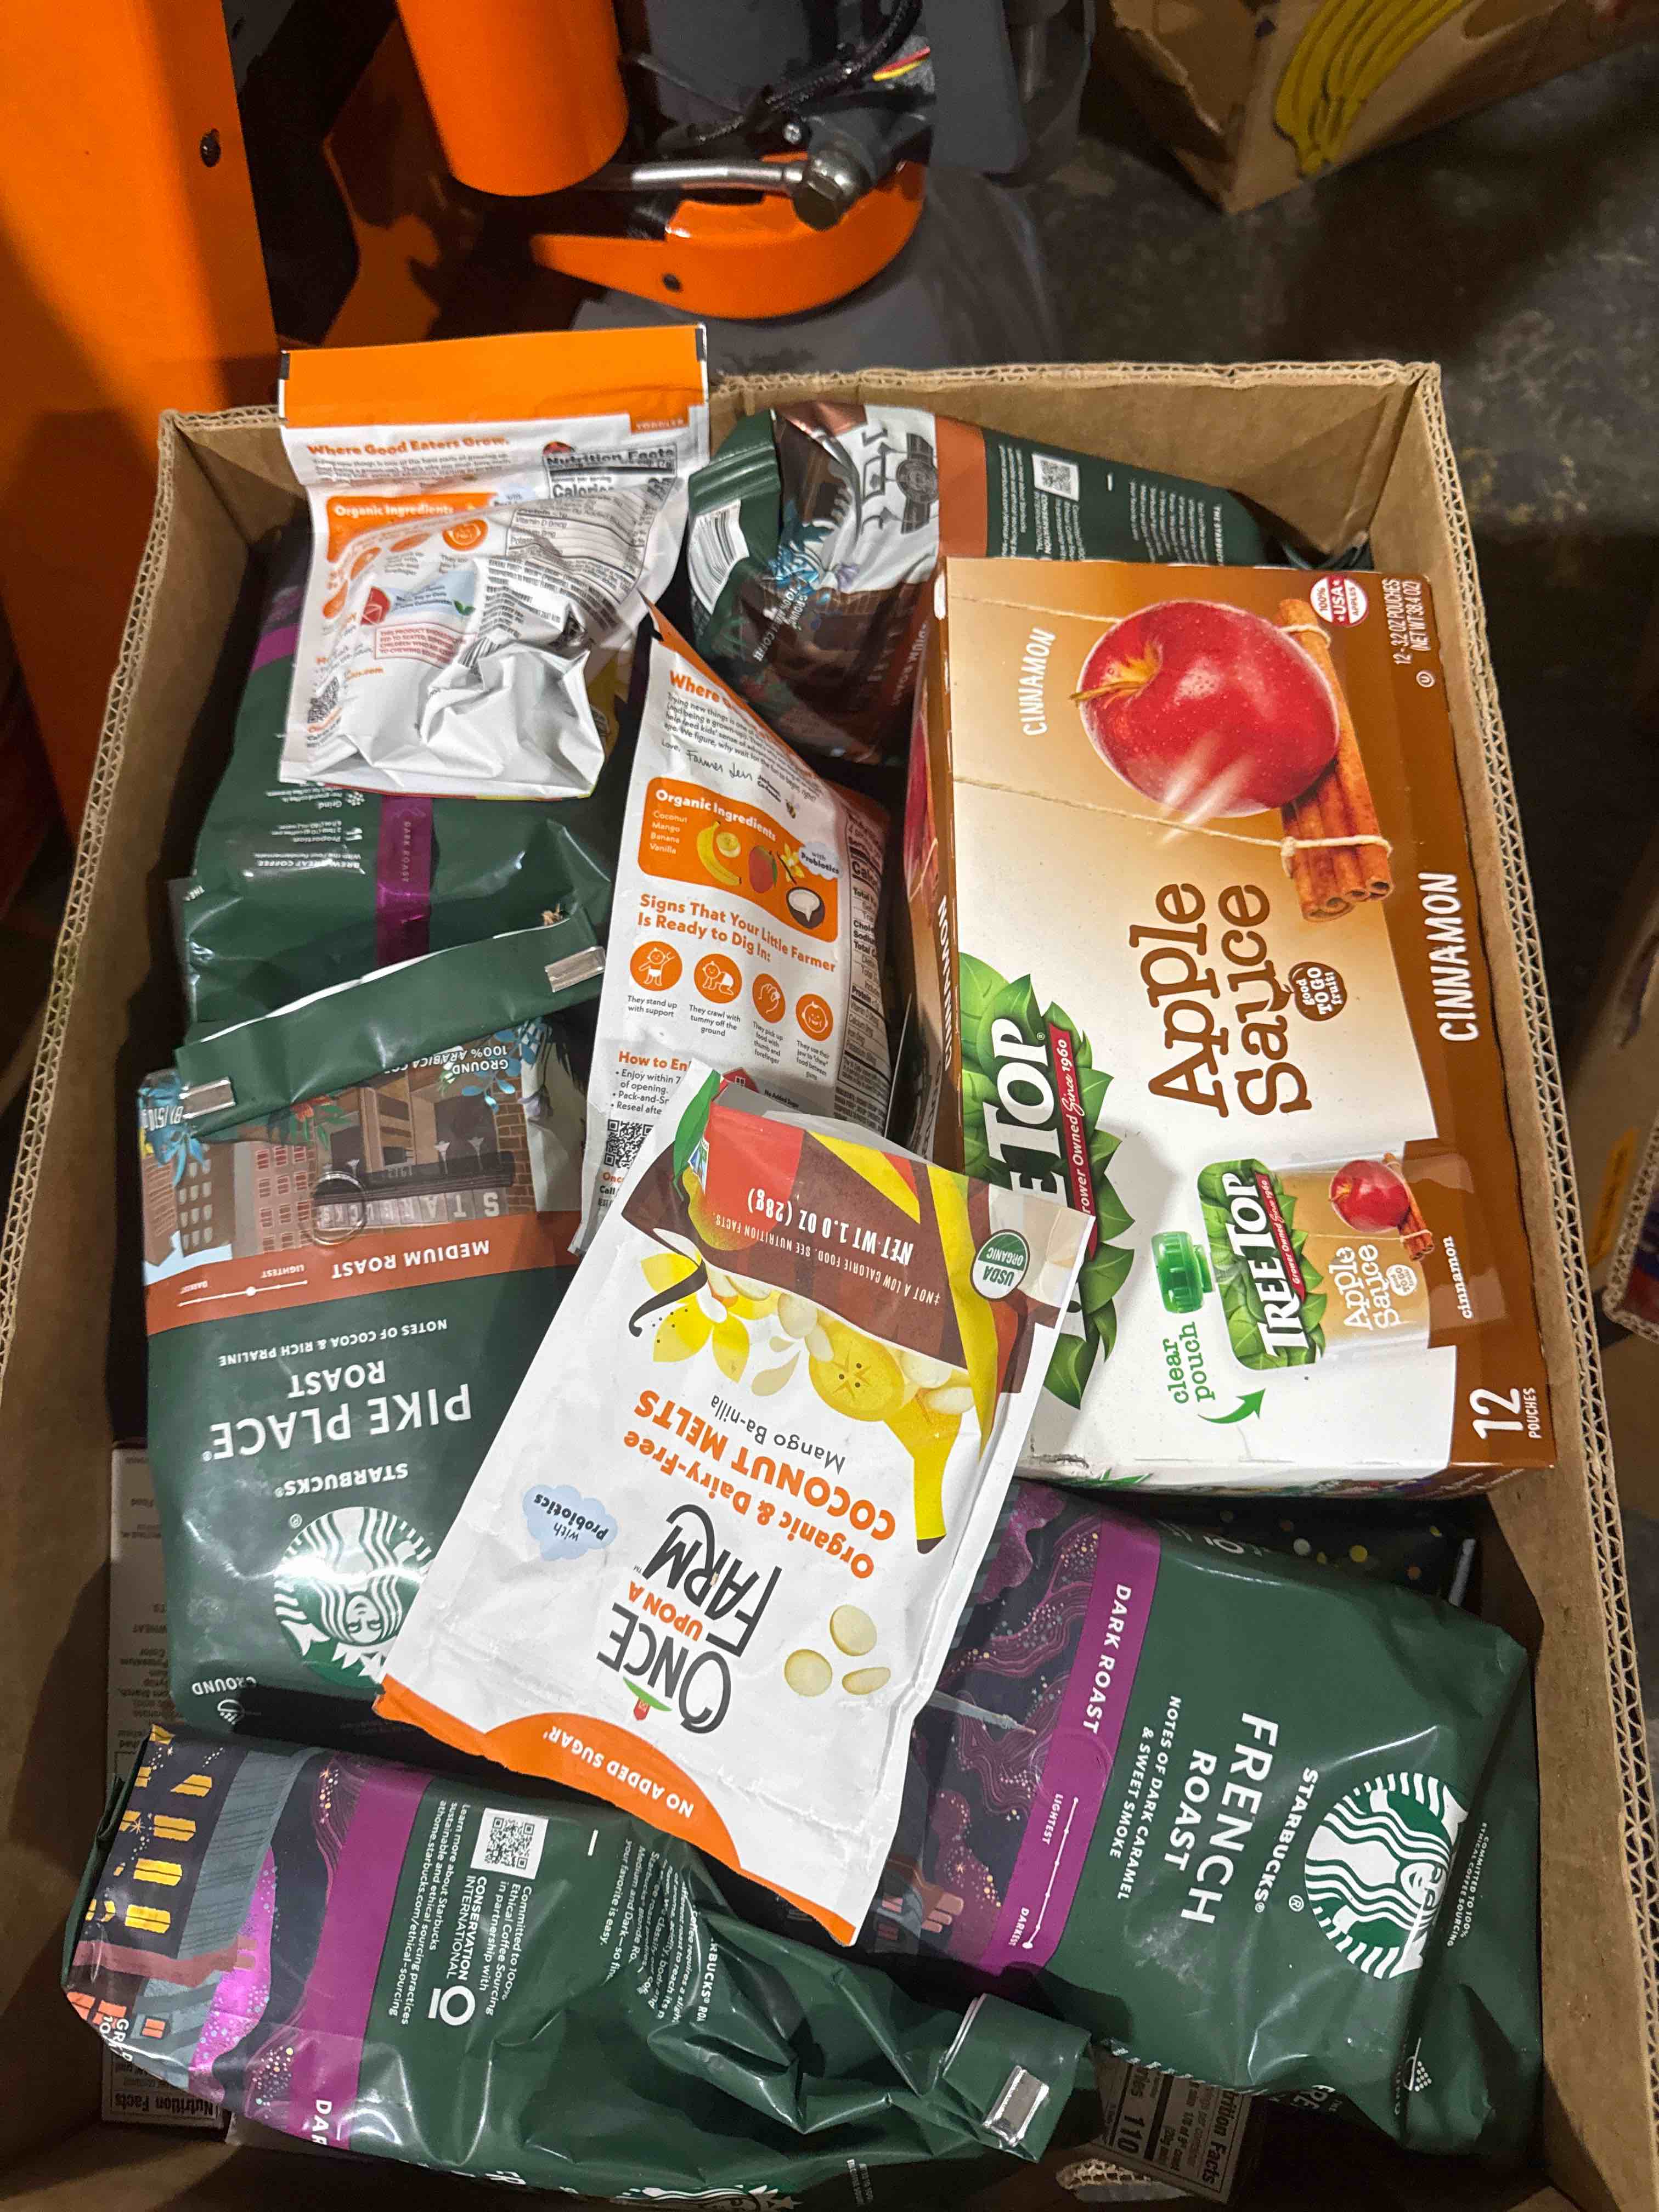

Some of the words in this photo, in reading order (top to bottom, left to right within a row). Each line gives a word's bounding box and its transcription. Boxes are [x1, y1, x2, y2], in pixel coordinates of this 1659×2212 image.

[307, 444, 361, 455] Where
[364, 441, 407, 455] Good
[410, 439, 460, 451] Eaters
[547, 453, 622, 466] Nutrition
[628, 448, 674, 460] Facts
[1331, 586, 1346, 614] USA
[1348, 588, 1359, 616] APPLES
[1382, 579, 1404, 619] POUCHES
[1403, 580, 1420, 595] OZ)
[1405, 597, 1424, 615] 38.4
[1408, 615, 1426, 630] WT
[1409, 632, 1430, 651] (NET
[669, 670, 720, 703] Where
[1022, 628, 1056, 737] CINNAMON
[668, 692, 689, 708] Trying
[690, 703, 706, 713] new
[707, 708, 728, 723] things
[686, 748, 723, 773] Farmer
[652, 822, 681, 833] Mango
[653, 811, 687, 823] Coconut
[656, 789, 712, 811] Organic
[713, 802, 776, 842] Ingredients
[650, 832, 680, 844] Banana
[650, 843, 676, 854] Vanilla
[637, 912, 651, 926] Is
[656, 915, 708, 940] Ready
[712, 926, 727, 941] to
[731, 932, 754, 955] Dig
[640, 893, 685, 913] Signs
[690, 901, 726, 923] That
[730, 912, 760, 934] Your
[761, 927, 789, 955] Little
[791, 945, 836, 973] Farmer
[1417, 872, 1480, 1042] CINNAMON
[938, 896, 952, 1071] CINNAMON
[1296, 979, 1315, 1005] good
[1307, 967, 1325, 990] GO
[628, 995, 644, 1007] They
[646, 998, 666, 1007] stand
[628, 1005, 644, 1013] with
[646, 1008, 674, 1018] support
[689, 1004, 706, 1016] They
[707, 1009, 725, 1019] crawl
[1128, 882, 1230, 1119] Apple
[1216, 883, 1311, 1115] Sauce
[1314, 992, 1333, 1014] TO
[691, 1015, 714, 1027] tummy
[701, 1026, 725, 1037] ground
[753, 1021, 766, 1034] They
[412, 1051, 467, 1068] ARABICA
[619, 1051, 651, 1066] How
[653, 1057, 668, 1068] to
[797, 1040, 810, 1052] They
[1057, 1039, 1074, 1072] 1960
[621, 1069, 645, 1082] Enjoy
[647, 1074, 674, 1084] within
[983, 1018, 1062, 1163] TOP
[617, 1102, 644, 1113] Reseal
[1065, 1116, 1087, 1166] Owned
[747, 1188, 793, 1224] (28g)
[799, 1209, 817, 1233] OZ
[1222, 1172, 1274, 1256] TOP
[712, 1213, 741, 1236] FACTS.
[744, 1224, 793, 1251] NUTRITION
[823, 1217, 849, 1243] 1.0
[853, 1227, 877, 1253] WT
[331, 1254, 396, 1279] ROAST
[404, 1240, 490, 1266] MEDIUM
[795, 1242, 811, 1258] SEE
[815, 1248, 841, 1268] FOOD.
[881, 1238, 913, 1266] NET
[985, 1247, 1024, 1267] ORGANIC
[844, 1258, 881, 1284] CALORIE
[885, 1275, 902, 1293] LOW
[983, 1266, 1015, 1286] USDA
[1358, 1244, 1401, 1328] Sauce
[1442, 1237, 1473, 1319] cinnamon
[1329, 1247, 1373, 1329] Apple
[1248, 1256, 1310, 1356] TREE
[331, 1330, 376, 1346] COCOA
[380, 1327, 398, 1338] OF
[401, 1318, 447, 1335] NOTES
[219, 1347, 276, 1366] PRALINE
[280, 1341, 313, 1356] RICH
[317, 1339, 327, 1350] &
[1178, 1321, 1214, 1401] pouch
[287, 1360, 385, 1398] ROAST
[1163, 1338, 1189, 1403] clear
[367, 1384, 471, 1435] PIKE
[634, 1389, 729, 1462] MELTS
[710, 1395, 767, 1446] Ba-nilla
[1470, 1389, 1522, 1440] 12
[1528, 1388, 1542, 1440] POUCHES
[773, 1432, 847, 1475] Mango
[623, 1430, 752, 1515] Dairy-Free
[731, 1447, 896, 1541] COCONUT
[534, 1493, 610, 1541] Probiotics
[756, 1500, 776, 1526] &
[553, 1522, 579, 1543] with
[778, 1511, 874, 1579] Organic
[628, 1581, 645, 1602] A
[642, 1504, 783, 1657] FARM
[642, 1592, 703, 1641] UPON
[1103, 1584, 1132, 1650] DARK
[596, 1602, 731, 1734] ONCE
[1082, 1654, 1115, 1734] ROAST
[1141, 1727, 1154, 1739] &
[1160, 1696, 1181, 1748] NOTES
[1127, 1743, 1150, 1796] SWEET
[1154, 1752, 1169, 1774] OF
[606, 1760, 664, 1800] ADDED
[666, 1793, 693, 1818] NO
[1141, 1778, 1165, 1822] DARK
[1164, 1750, 1217, 1871] ROAST
[437, 1803, 457, 1861] sustainable
[455, 1804, 470, 1832] Learn
[1041, 1793, 1064, 1844] LIGHTEST
[1109, 1801, 1136, 1859] SMOKE
[1180, 1712, 1279, 1924] FRENCH
[449, 1835, 462, 1862] more
[1118, 1826, 1150, 1901] CARAMEL
[1469, 1836, 1489, 1893] COMMITTED
[432, 1863, 443, 1883] and
[441, 1864, 455, 1896] about
[499, 1881, 509, 1892] in
[612, 1865, 629, 1905] favorite
[389, 1801, 447, 2016] athome.starbucks.com/ethical-sourcing
[424, 1885, 438, 1922] ethical
[504, 1883, 520, 1922] Ethical
[512, 1886, 532, 1951] Committed
[429, 1897, 447, 1950] Starbucks
[447, 1875, 476, 1979] INTERNATIONAL
[458, 1876, 487, 1980] CONSERVATION
[483, 1894, 503, 1962] partnership
[1008, 1907, 1030, 1946] DARKEST
[1447, 1898, 1465, 1946] SOURCING
[411, 1924, 429, 1971] sourcing
[497, 1924, 512, 1961] Coffee
[510, 1953, 519, 1966] to
[681, 1945, 695, 1986] requires
[479, 1965, 490, 1991] with
[486, 1964, 505, 2016] Sourcing
[502, 1967, 517, 2000] 100%
[401, 1973, 419, 2024] practices
[115, 2094, 149, 2111] Facts
[155, 2097, 213, 2115] Nutrition
[1118, 2115, 1145, 2154] 110
[1202, 2142, 1227, 2183] Facts
